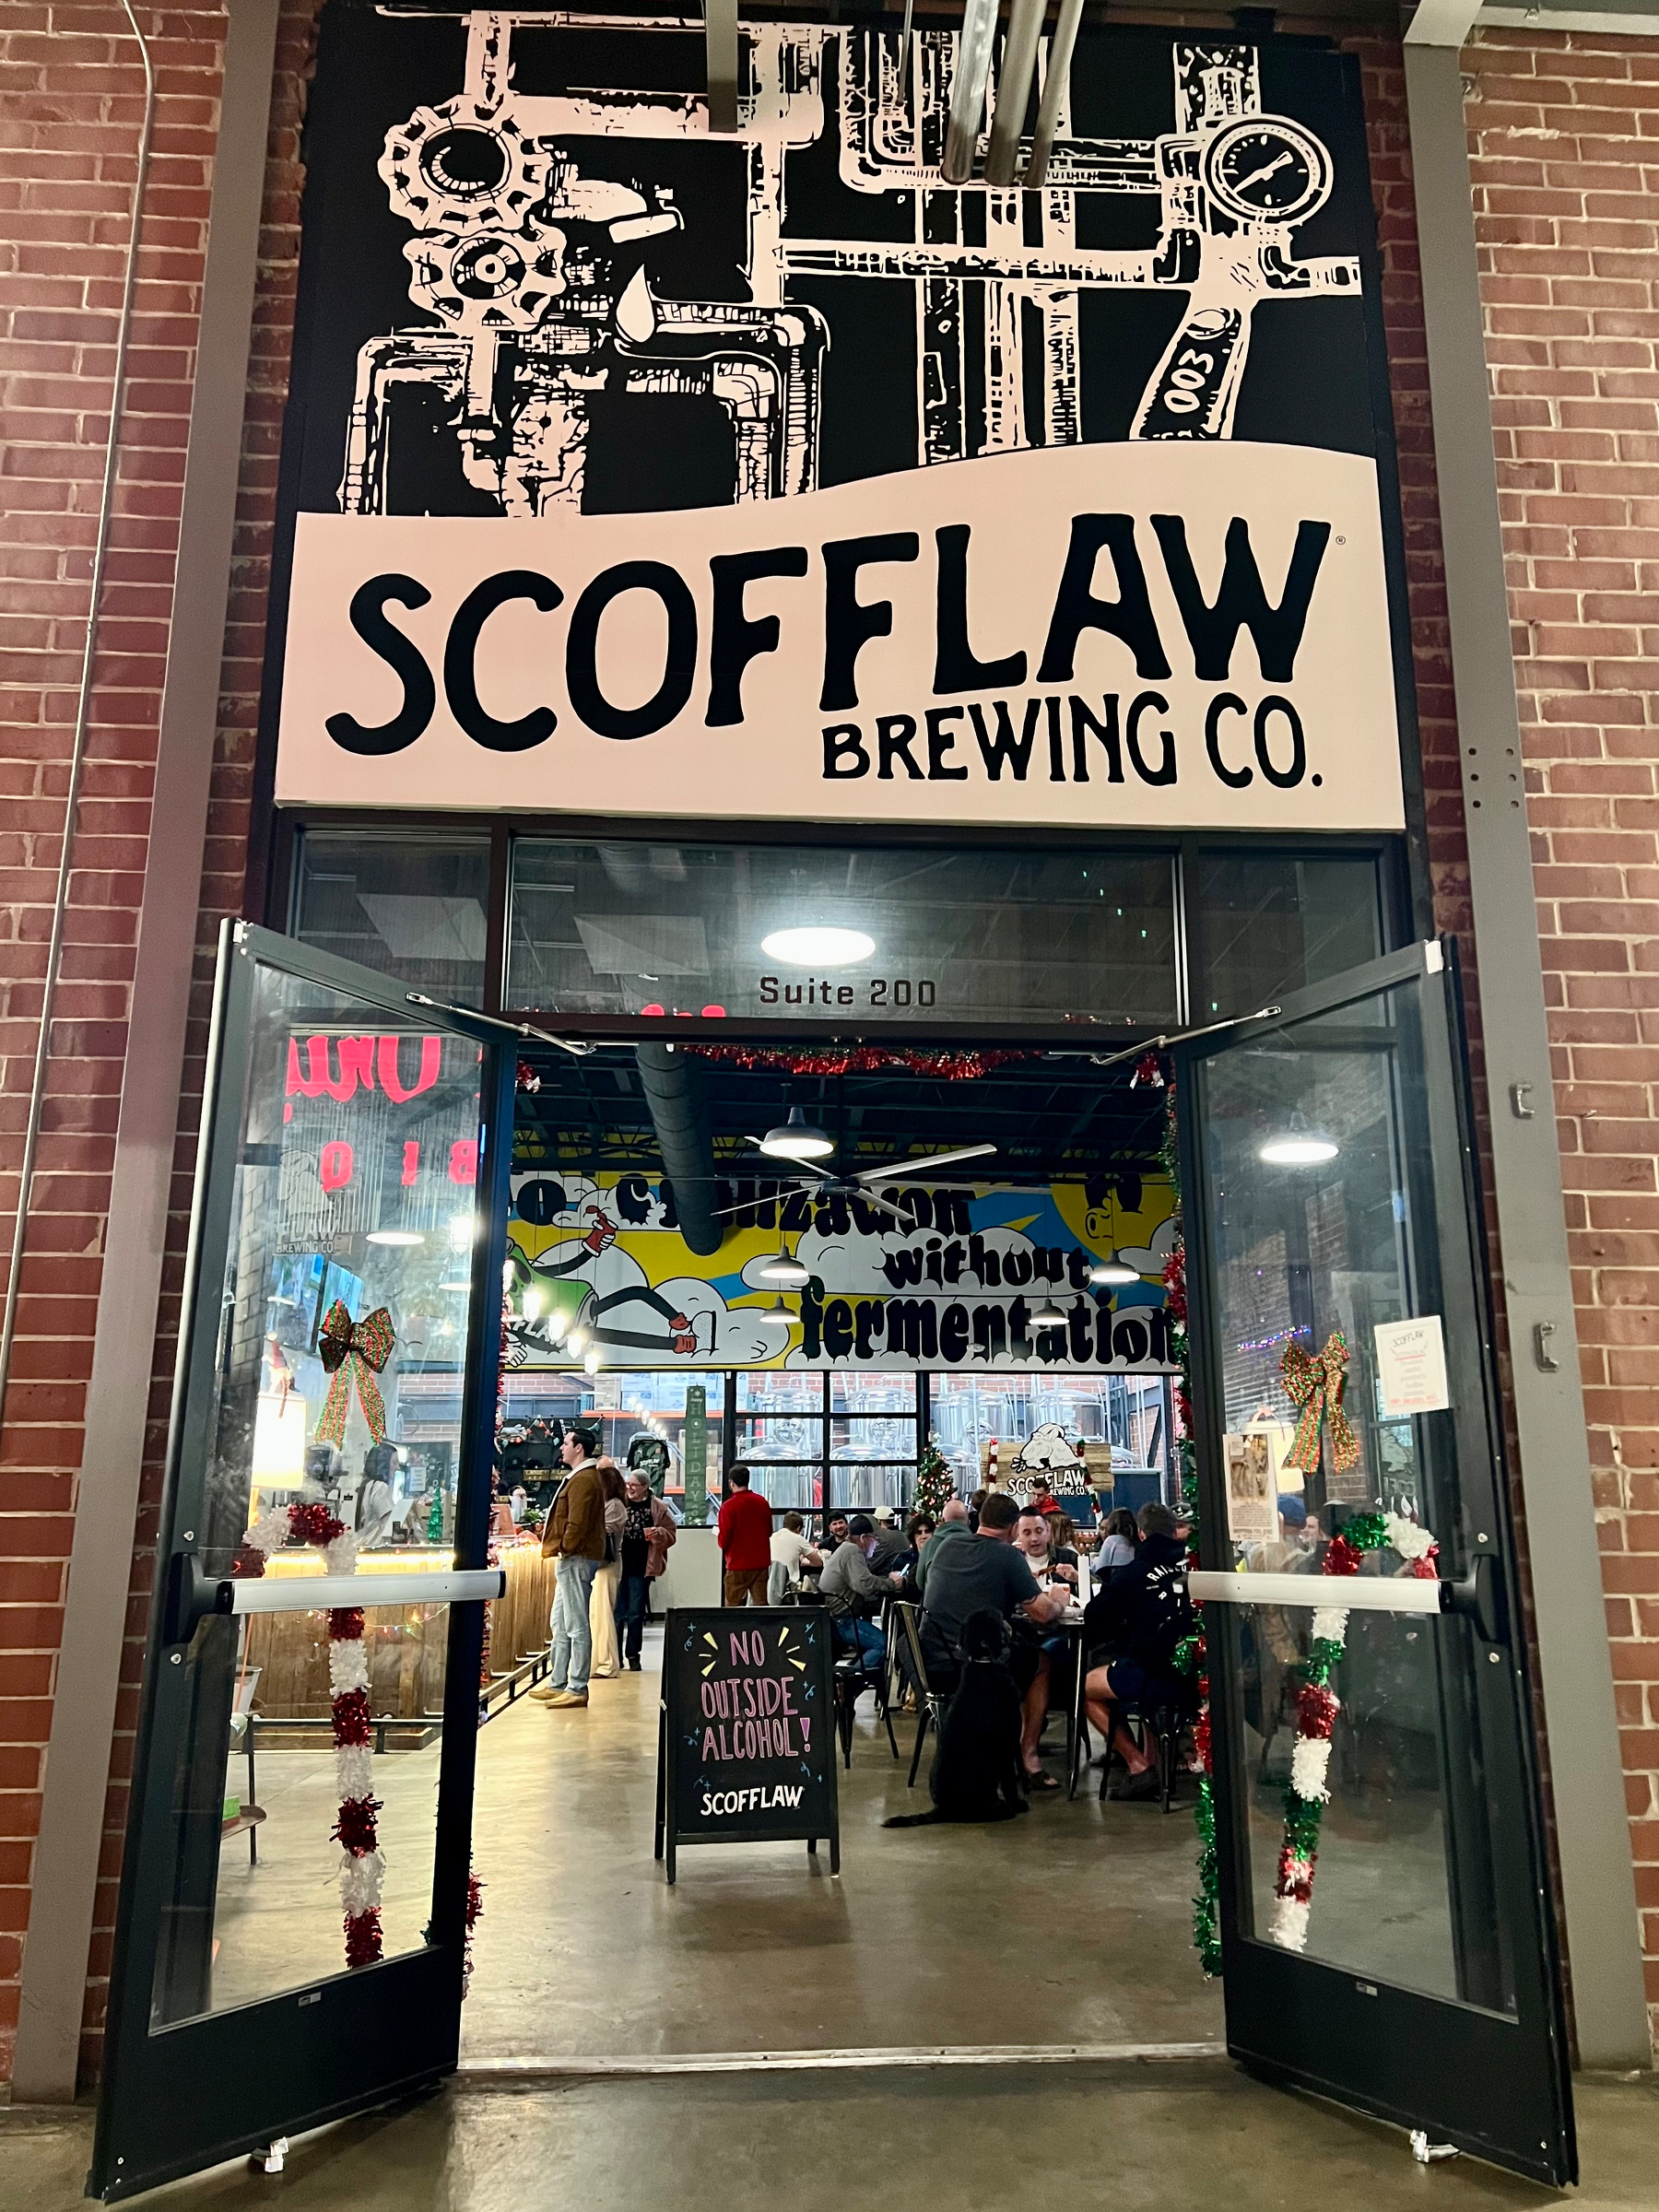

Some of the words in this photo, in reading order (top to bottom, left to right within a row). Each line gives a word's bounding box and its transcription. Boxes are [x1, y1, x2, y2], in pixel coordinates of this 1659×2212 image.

[1164, 348, 1214, 414] 003
[325, 513, 1332, 755] SCOFFLAW
[822, 691, 1178, 786] BREWING
[1206, 692, 1322, 788] CO.
[759, 976, 853, 1005] Suite
[870, 979, 935, 1006] 200
[276, 1241, 318, 1253] BREWING
[885, 1235, 1089, 1289] without
[800, 1276, 1176, 1365] fermentation
[1007, 1469, 1086, 1496] SCOFLAW
[729, 1630, 765, 1666] NO
[701, 1677, 798, 1719] OUTSIDE
[700, 1785, 803, 1816] SCOFFLAW
